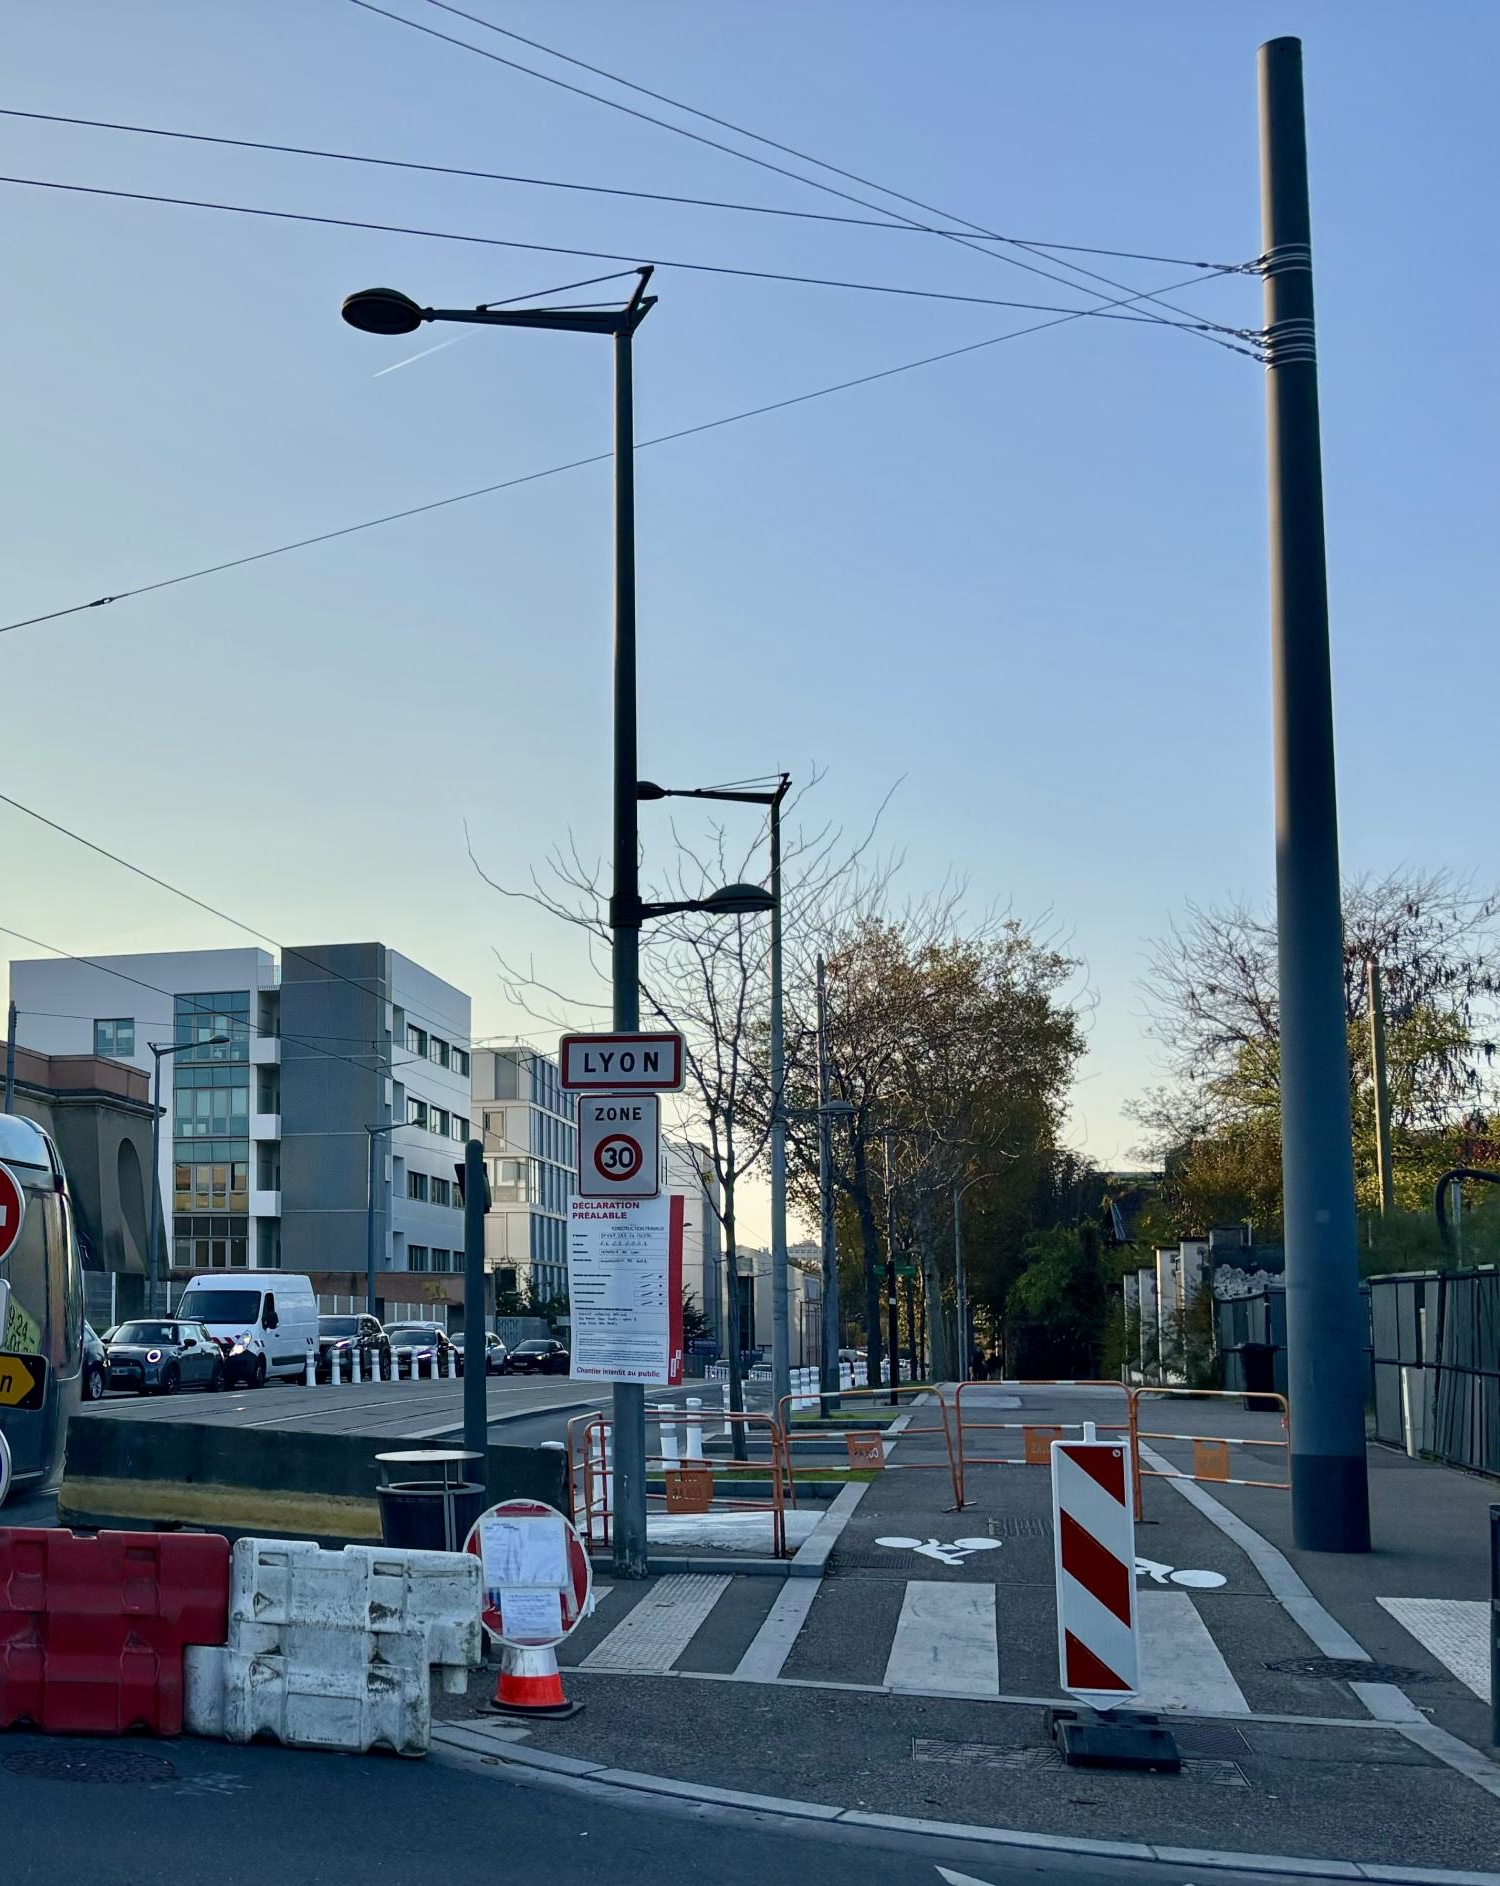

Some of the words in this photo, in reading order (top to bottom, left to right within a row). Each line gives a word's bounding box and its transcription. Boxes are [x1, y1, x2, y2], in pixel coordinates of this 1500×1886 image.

[583, 1051, 659, 1073] LYON
[594, 1107, 642, 1121] ZONE
[603, 1147, 634, 1169] 30
[572, 1201, 640, 1210] DÉCLARATION
[572, 1211, 628, 1220] PRÉALABLE
[638, 1369, 661, 1378] public
